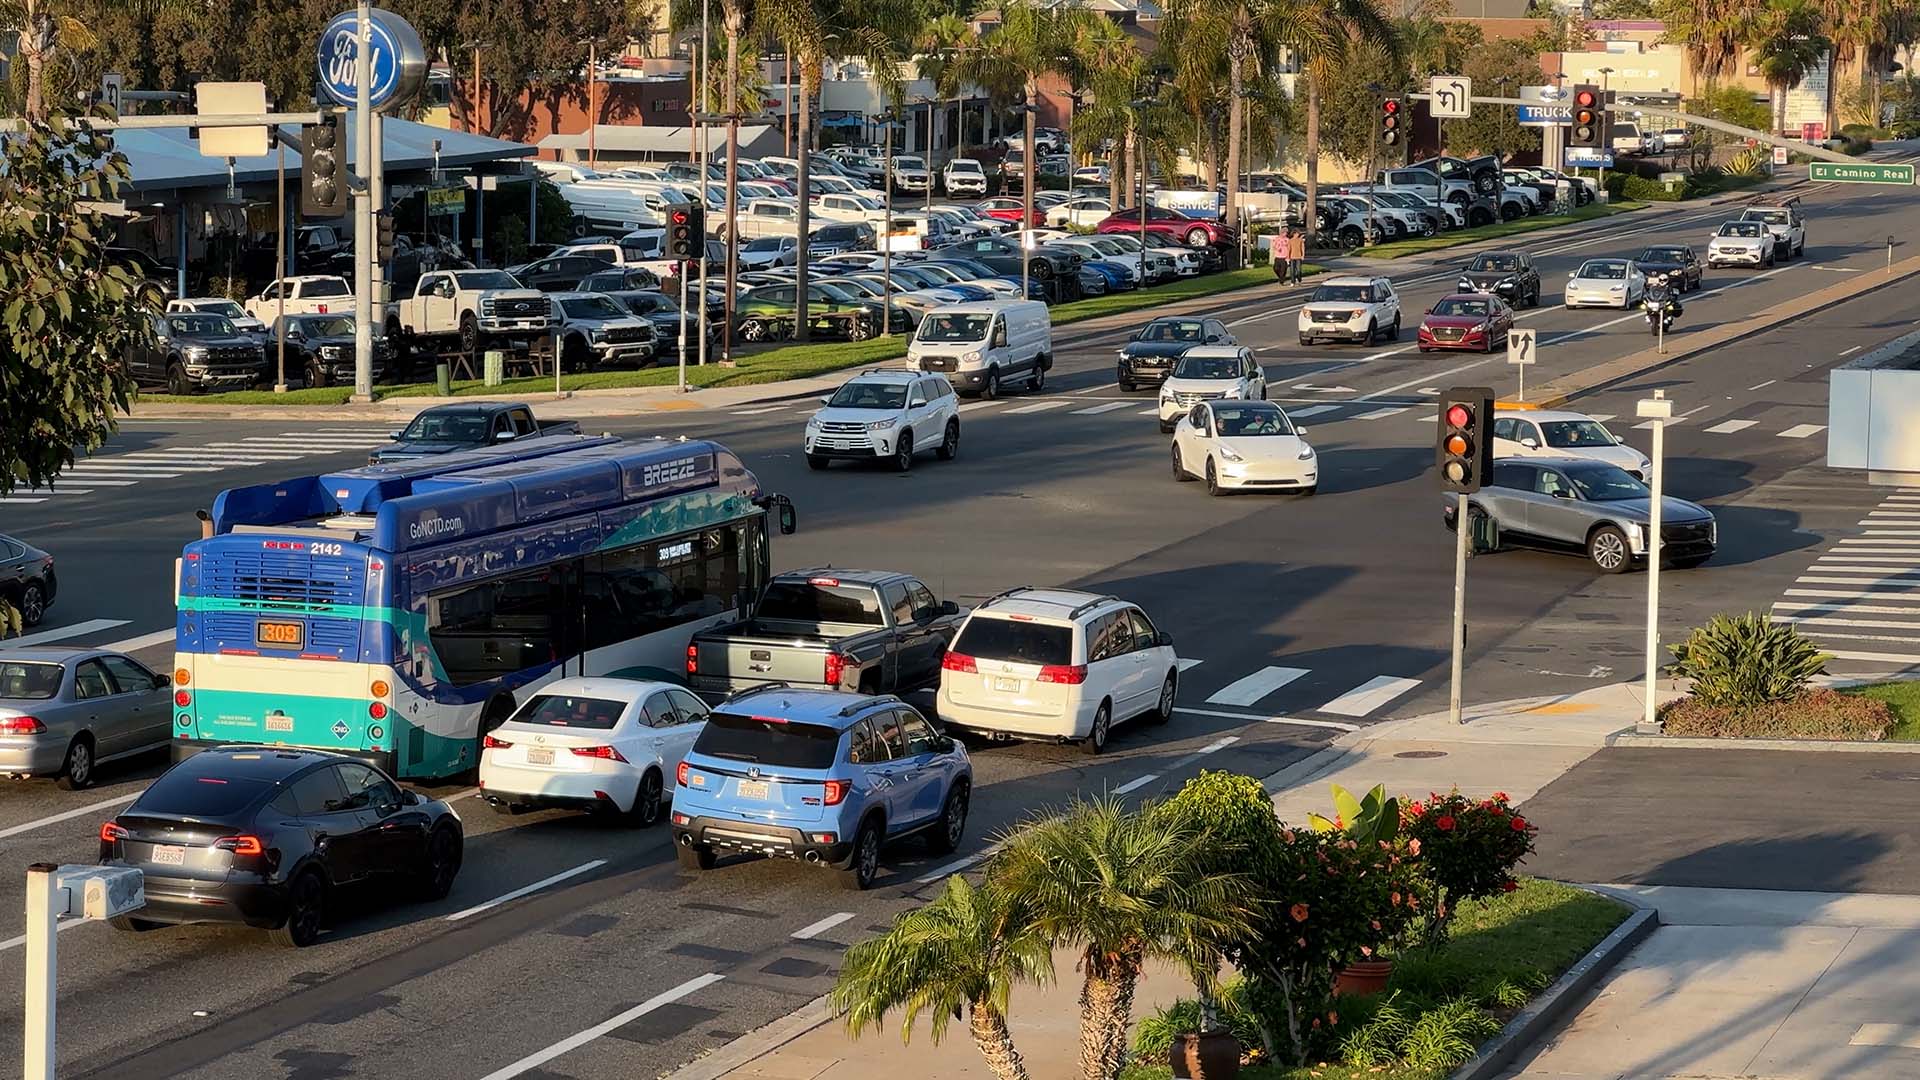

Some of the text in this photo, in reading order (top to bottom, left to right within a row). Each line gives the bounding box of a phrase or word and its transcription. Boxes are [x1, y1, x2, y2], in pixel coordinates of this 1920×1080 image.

[1816, 168, 1908, 179] El Camino Real
[1170, 199, 1216, 210] SERVICE
[644, 457, 695, 486] BREEZE
[410, 517, 462, 539] GoNCTD.com
[311, 542, 342, 556] 2142
